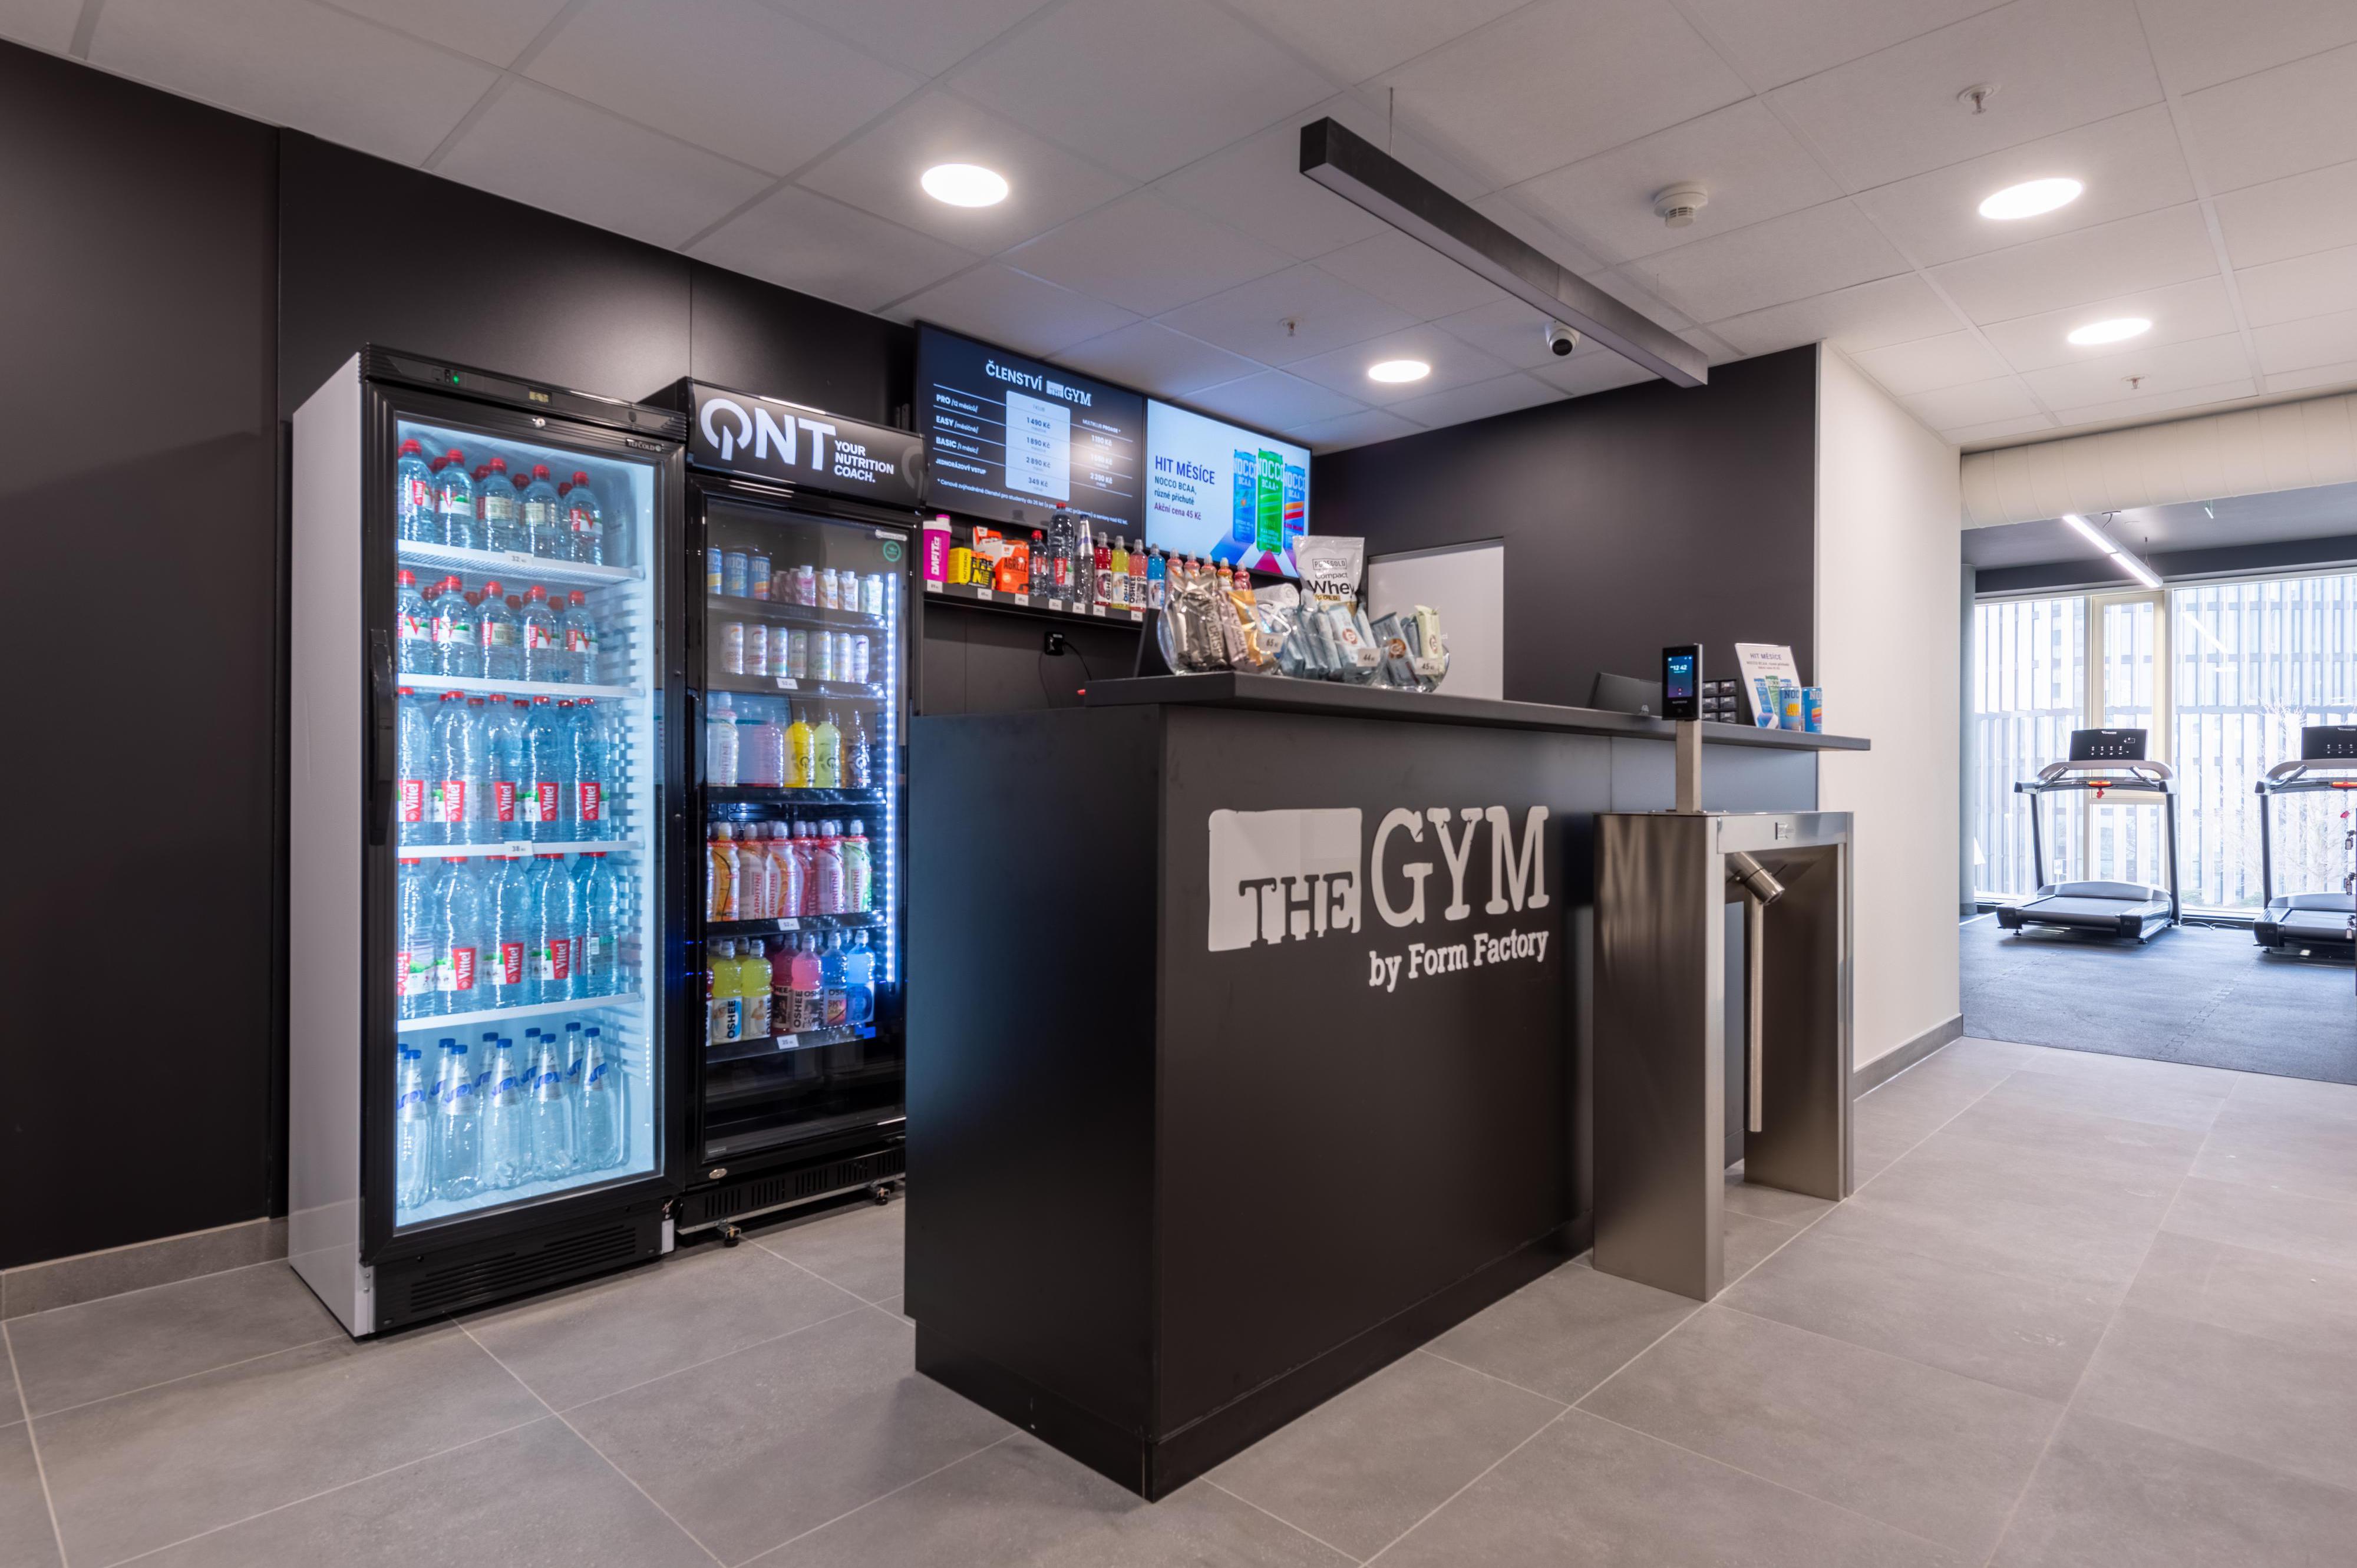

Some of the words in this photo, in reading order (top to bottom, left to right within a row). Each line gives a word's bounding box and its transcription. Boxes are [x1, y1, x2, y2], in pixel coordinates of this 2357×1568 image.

[985, 359, 1042, 391] ČLENSTVÍ
[1063, 387, 1092, 407] GYM
[936, 394, 950, 404] PRO
[936, 415, 953, 427] EASY
[1031, 418, 1042, 427] 490
[1043, 420, 1051, 429] Kč
[700, 398, 836, 471] QNT
[936, 437, 956, 448] BASIC
[834, 440, 866, 457] YOUR
[833, 465, 876, 483] COACH.
[834, 453, 894, 475] NUTRITION
[1155, 455, 1173, 473] HIT
[1177, 460, 1215, 485] MĚSÍCE
[1154, 476, 1177, 488] NOCCO
[1178, 482, 1197, 495] BCAA,
[1238, 477, 1252, 487] BCAA
[1288, 489, 1300, 499] BCAA
[1154, 488, 1170, 500] různé
[1171, 493, 1194, 505] příchutě
[1154, 502, 1170, 513] Akční
[1171, 507, 1185, 517] cena
[1186, 510, 1193, 519] 45
[1194, 511, 1201, 520] Kč
[1306, 580, 1354, 598] Whey
[405, 783, 419, 811] Vittel
[500, 785, 511, 811] Vittel
[543, 785, 554, 811] Vittel
[585, 785, 596, 811] Vittel
[1239, 871, 1354, 947] THE
[1371, 805, 1550, 928] GYM
[458, 951, 471, 980] Vittel
[508, 947, 519, 974] Vittel
[556, 943, 567, 969] Vittel
[1369, 950, 1401, 992] by
[1408, 943, 1468, 979] Form
[1473, 929, 1549, 966] Factory
[727, 1001, 736, 1039] OSHEE
[794, 991, 803, 1028] OSHEE
